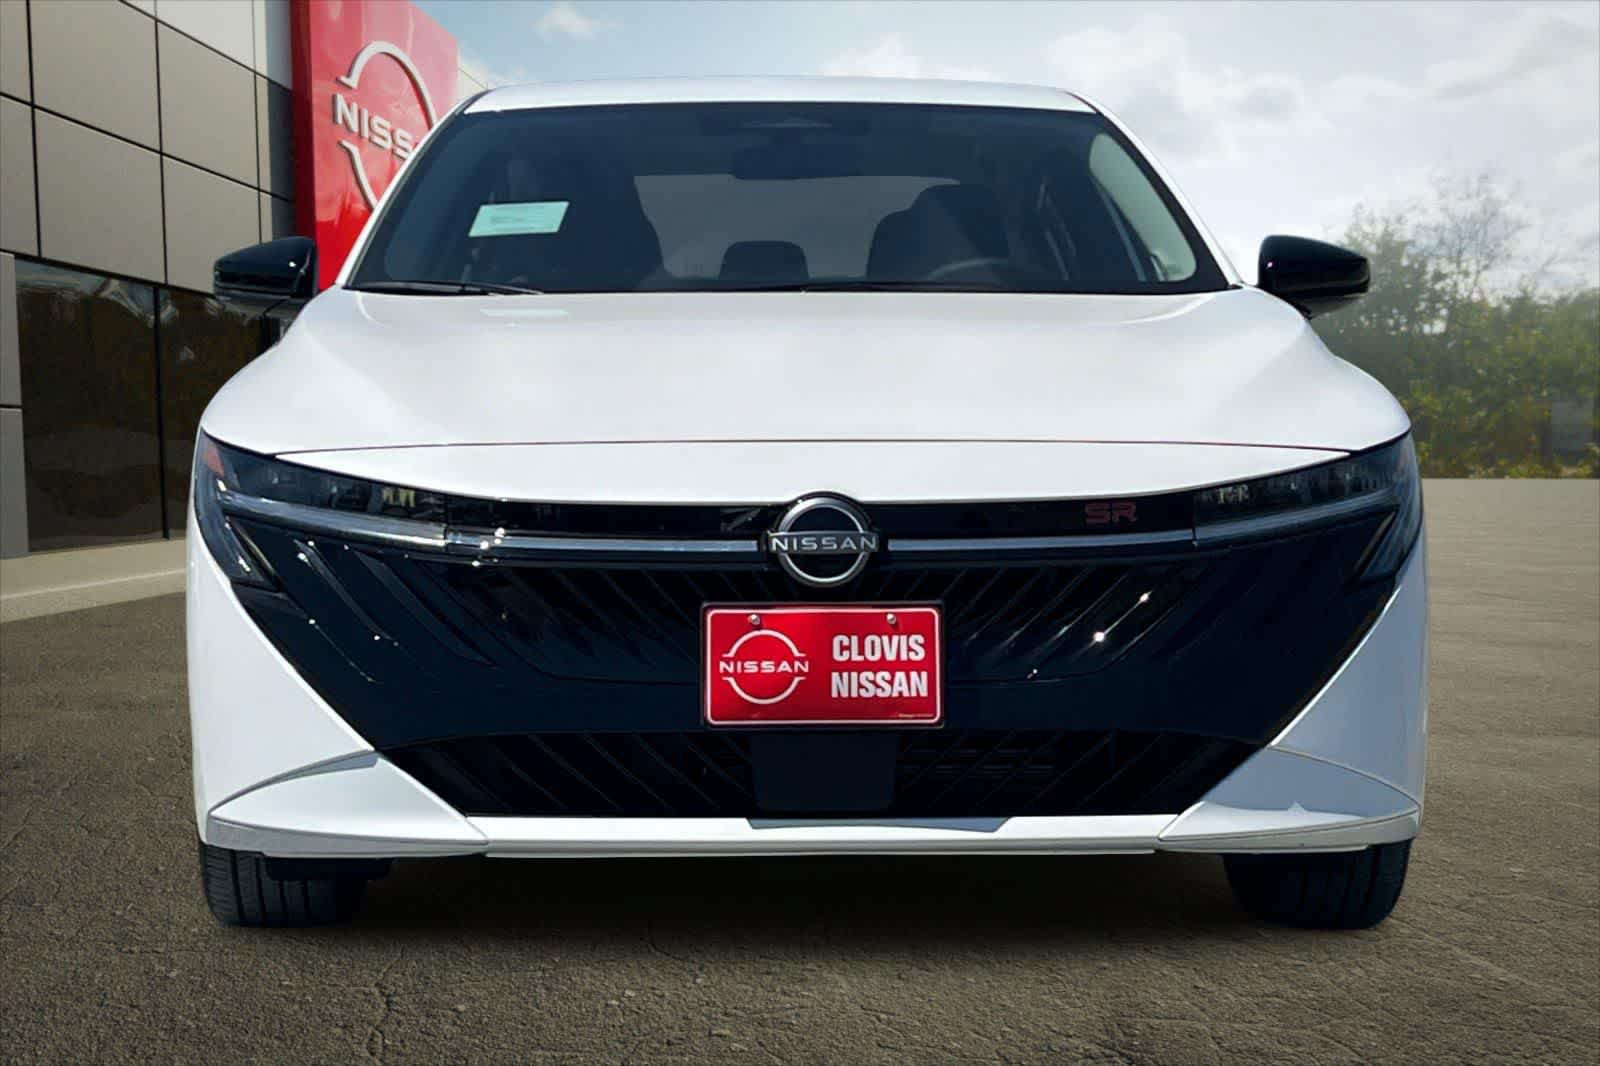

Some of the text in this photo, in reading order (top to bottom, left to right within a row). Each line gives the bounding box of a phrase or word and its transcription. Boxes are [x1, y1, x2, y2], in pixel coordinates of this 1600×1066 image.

[333, 92, 419, 161] NISS
[1084, 502, 1137, 523] SR
[771, 536, 876, 551] NISSAN
[832, 634, 926, 662] CLOVIS
[719, 660, 809, 673] NISSAN
[831, 671, 928, 698] NISSAN
